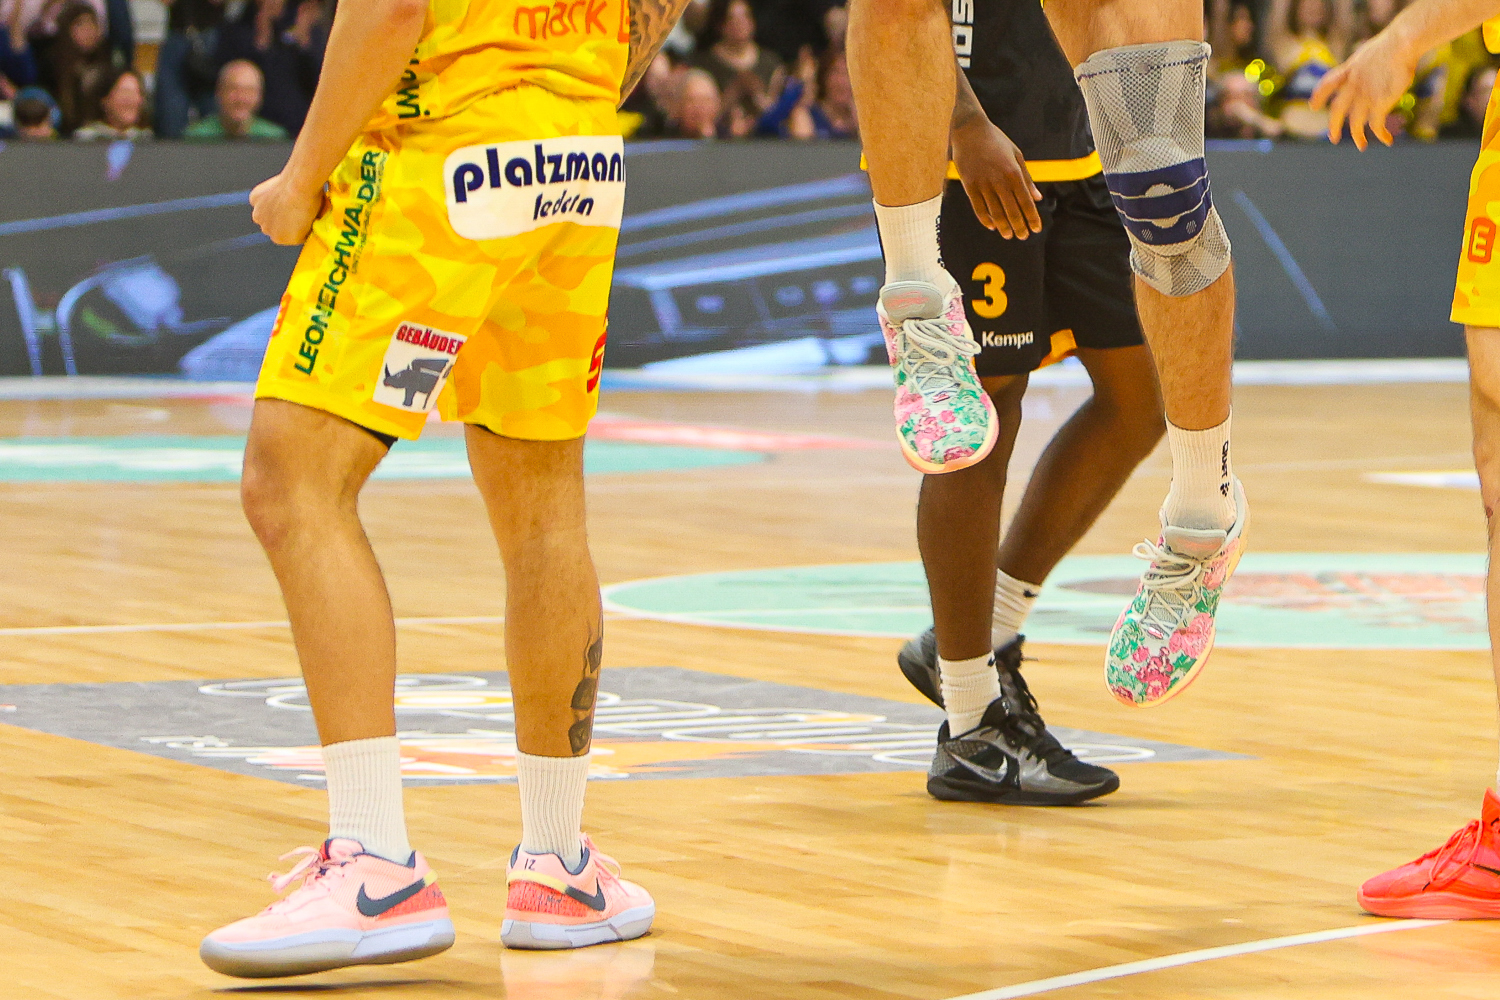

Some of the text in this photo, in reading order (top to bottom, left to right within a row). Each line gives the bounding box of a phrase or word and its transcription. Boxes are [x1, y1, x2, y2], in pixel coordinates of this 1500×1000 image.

[453, 143, 625, 204] platzman
[971, 261, 1008, 319] 3
[982, 330, 1034, 350] Kempa
